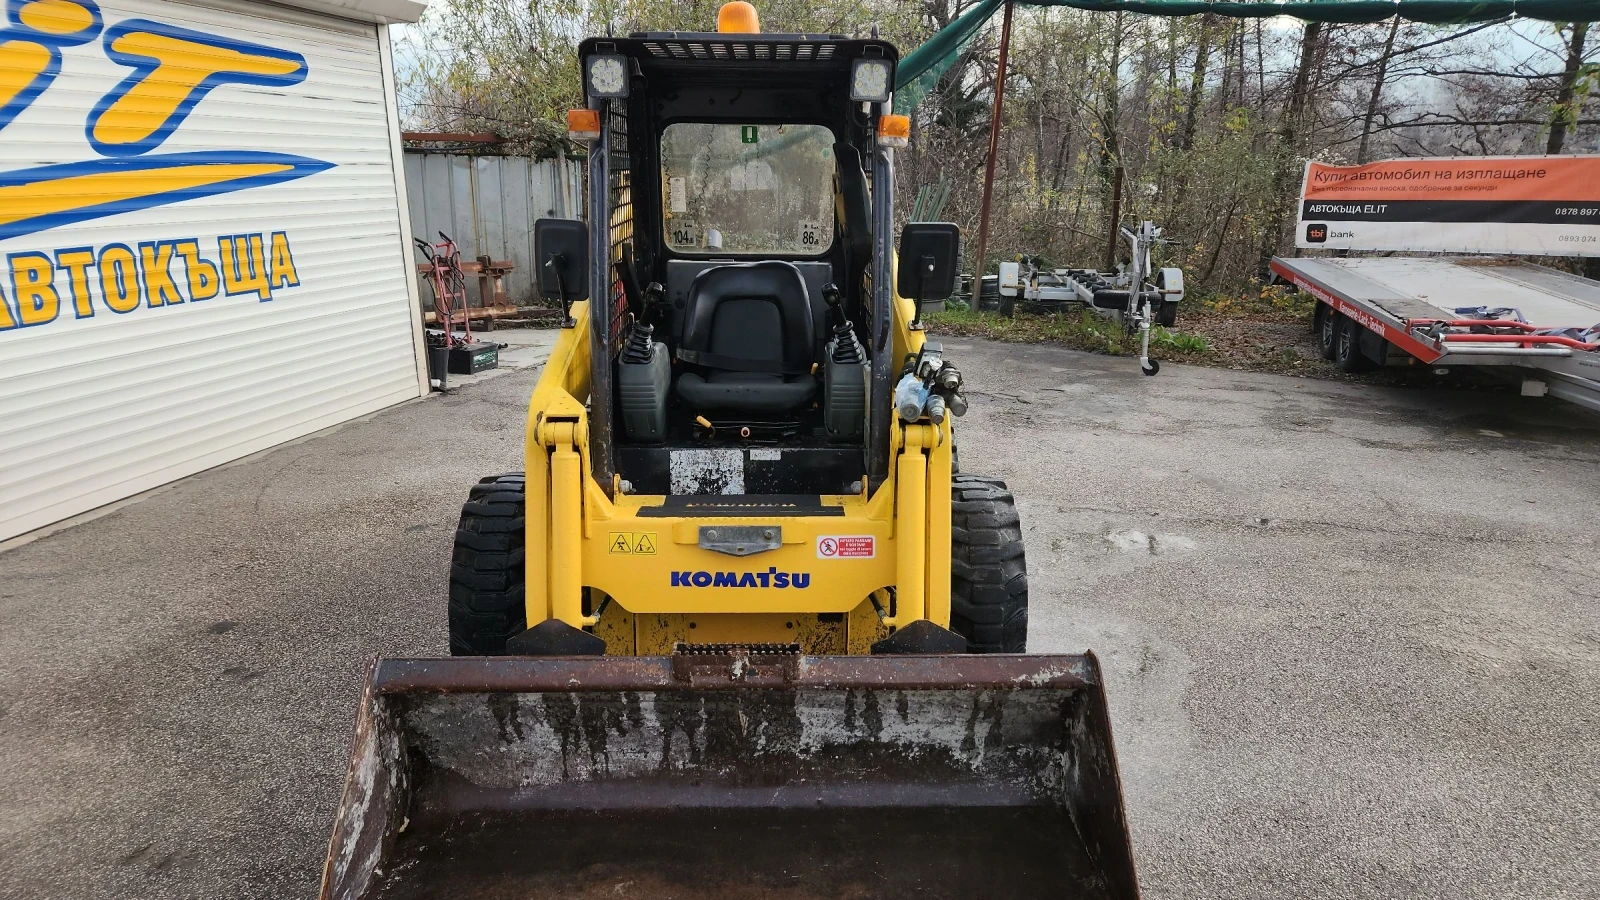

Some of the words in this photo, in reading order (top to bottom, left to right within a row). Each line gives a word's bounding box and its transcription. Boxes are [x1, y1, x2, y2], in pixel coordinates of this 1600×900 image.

[1314, 170, 1347, 184] Купи
[1350, 168, 1430, 181] автомобил
[1434, 170, 1452, 180] на
[1456, 168, 1547, 181] изплащане
[1326, 185, 1378, 193] първоначална
[1379, 184, 1408, 192] вноска,
[1408, 184, 1452, 193] одобрение
[1463, 184, 1498, 193] секунди
[1309, 204, 1362, 214] АВТОКЪЩА
[1363, 204, 1388, 214] ELIT
[1554, 207, 1578, 216] 0878
[1580, 208, 1598, 216] 897
[672, 229, 689, 244] 104
[802, 230, 815, 245] 86
[1310, 229, 1325, 238] tbi
[1330, 230, 1355, 239] bank
[1558, 234, 1580, 243] 0893
[1581, 235, 1597, 243] 074
[670, 566, 810, 589] KOMATSU
